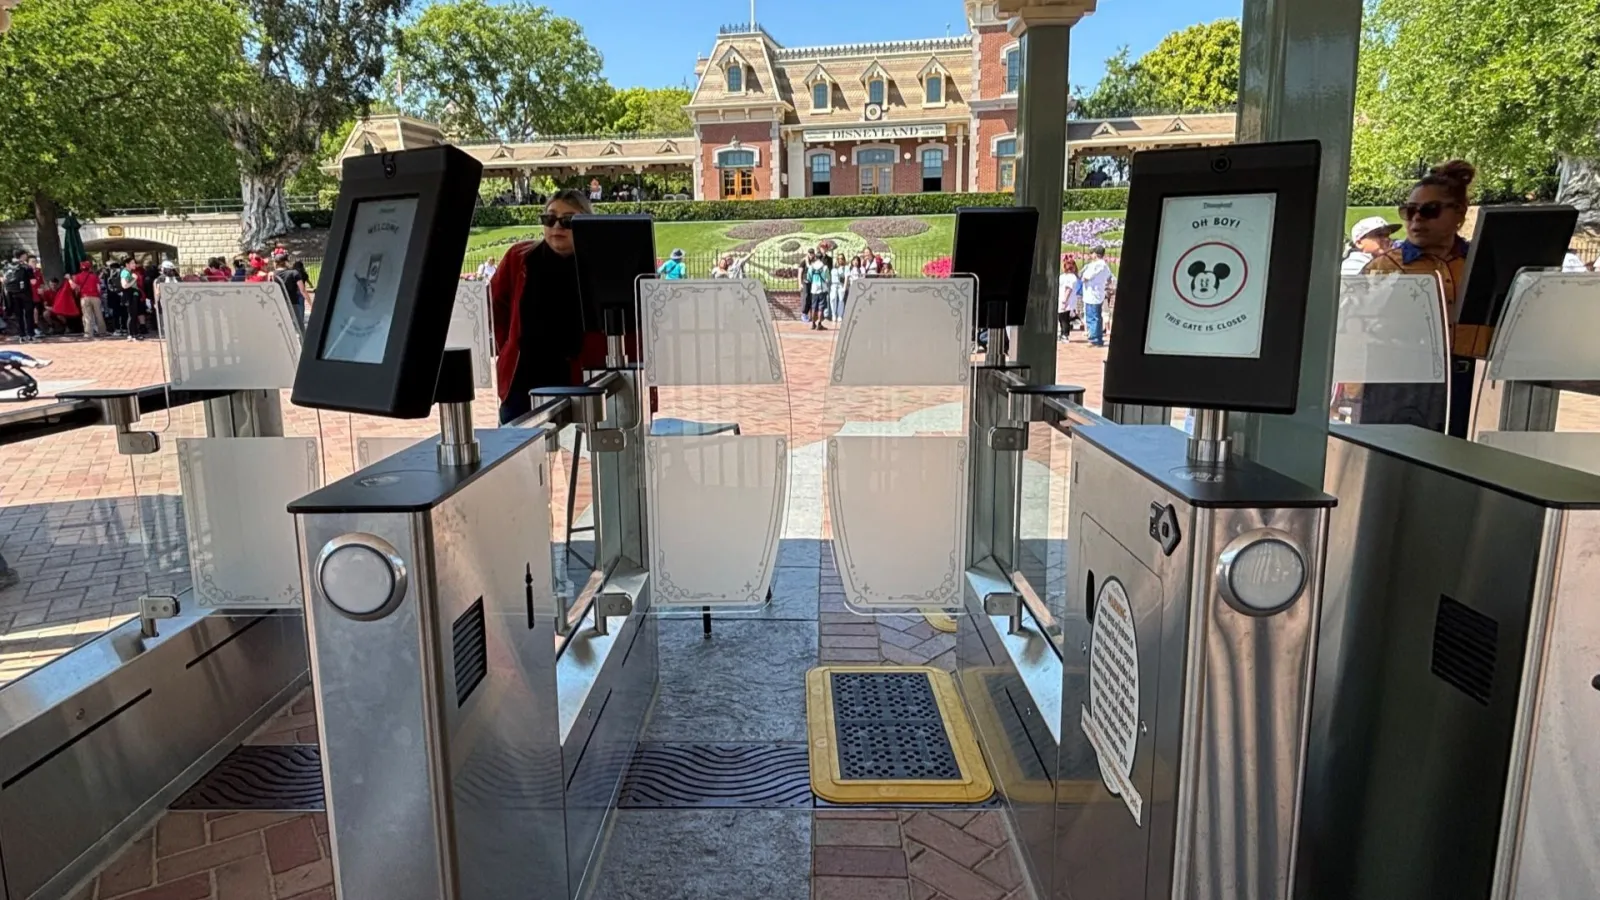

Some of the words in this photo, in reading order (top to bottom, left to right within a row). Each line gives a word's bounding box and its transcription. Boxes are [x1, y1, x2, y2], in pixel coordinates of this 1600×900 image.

[832, 127, 919, 139] DISNEYLAND
[1192, 218, 1208, 229] OH
[1214, 217, 1241, 228] BOY!
[1164, 312, 1181, 326] THIS
[1182, 322, 1202, 332] GATE
[1216, 313, 1247, 330] CLOSED
